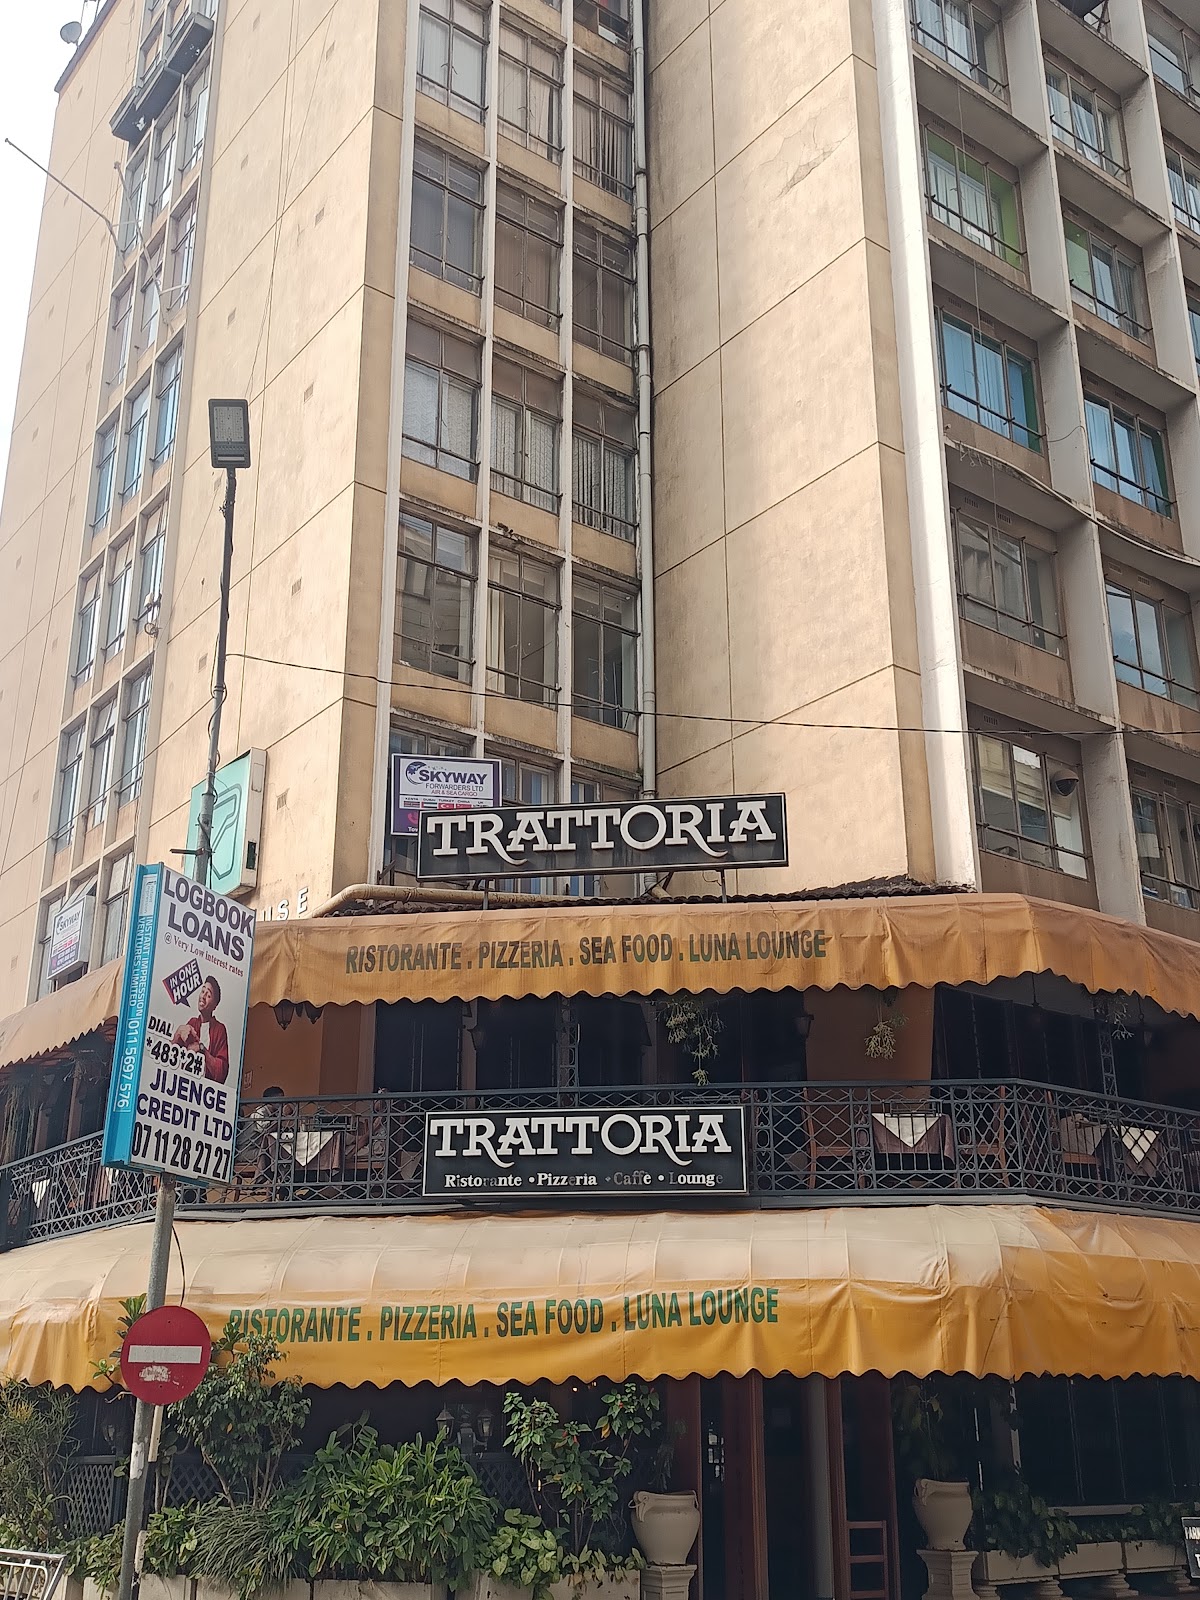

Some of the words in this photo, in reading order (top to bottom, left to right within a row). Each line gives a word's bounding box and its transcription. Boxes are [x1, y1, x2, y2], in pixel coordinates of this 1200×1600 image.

[418, 769, 488, 785] SKYWAY
[425, 782, 471, 792] FORWARDERS
[426, 800, 777, 866] TRATTORIA
[163, 869, 255, 939] LOGBOOK
[133, 916, 145, 967] VENTURES
[142, 916, 153, 955] INSTANT
[167, 902, 245, 962] LOANS
[345, 942, 462, 974] RISTORANTE
[478, 939, 564, 969] PIZZERIA
[579, 935, 617, 965] SEA
[621, 933, 673, 963] FOOD
[689, 931, 741, 963] LUNA
[745, 929, 826, 960] LOUNGE
[169, 975, 178, 989] IN
[178, 960, 198, 982] ONE
[173, 935, 189, 952] Very
[190, 943, 205, 958] Low
[205, 951, 229, 970] interest
[228, 965, 244, 977] rates
[130, 969, 140, 1007] LIMITED
[136, 957, 149, 1017] IMPRESSION
[172, 972, 201, 1003] HOUR
[126, 1020, 140, 1044] 011
[147, 1015, 173, 1038] DIAL
[121, 1047, 137, 1080] 5697
[117, 1083, 131, 1108] 576
[149, 1068, 228, 1114] JIJENGE
[136, 1093, 200, 1132] CREDIT
[203, 1114, 233, 1142] LTD
[429, 1113, 732, 1169] TRATTORIA
[444, 1173, 522, 1188] Ristorante
[536, 1172, 598, 1187] Pizzeria
[669, 1171, 723, 1187] Lounge
[229, 1306, 361, 1343] RISTORANTE
[380, 1304, 477, 1341] PIZZERIA
[496, 1300, 538, 1338] SEA
[545, 1298, 604, 1335] FOOD
[623, 1292, 682, 1332] LUNA
[688, 1287, 779, 1326] LOUNGE
